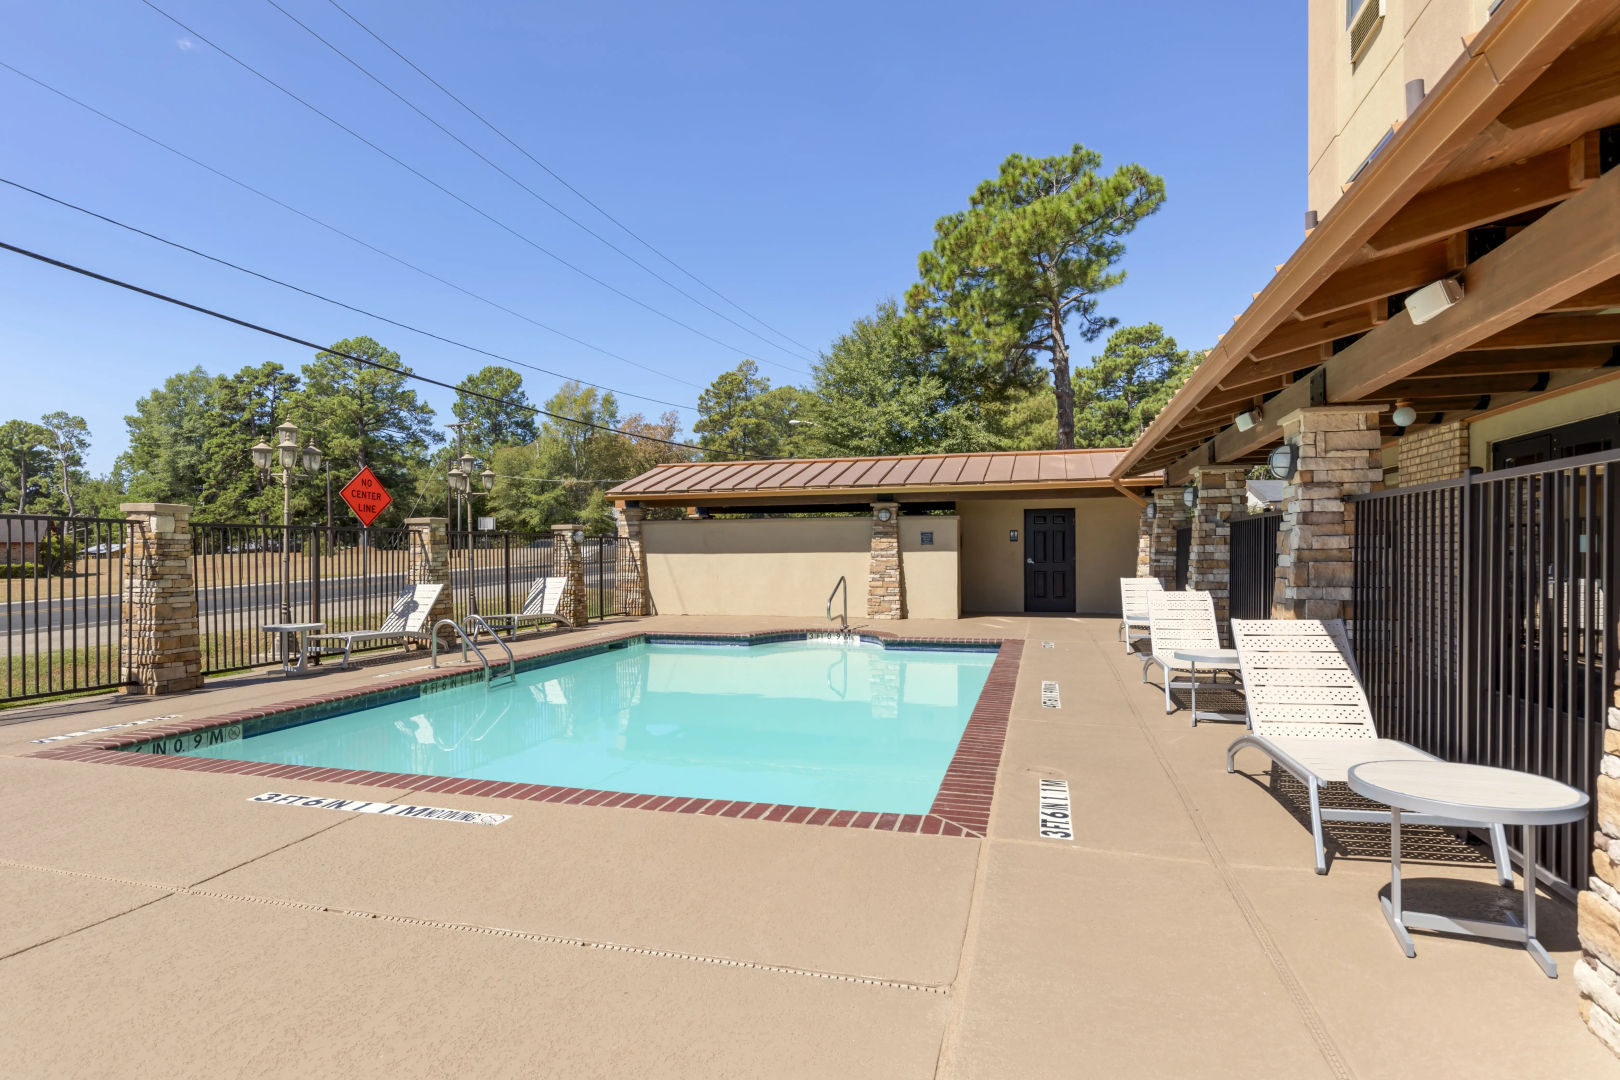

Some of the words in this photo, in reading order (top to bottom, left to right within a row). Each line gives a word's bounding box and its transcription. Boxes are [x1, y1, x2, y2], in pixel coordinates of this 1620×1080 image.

[361, 478, 372, 487] NO
[351, 489, 381, 501] CENTER
[358, 503, 376, 513] LINE
[209, 728, 224, 745] M
